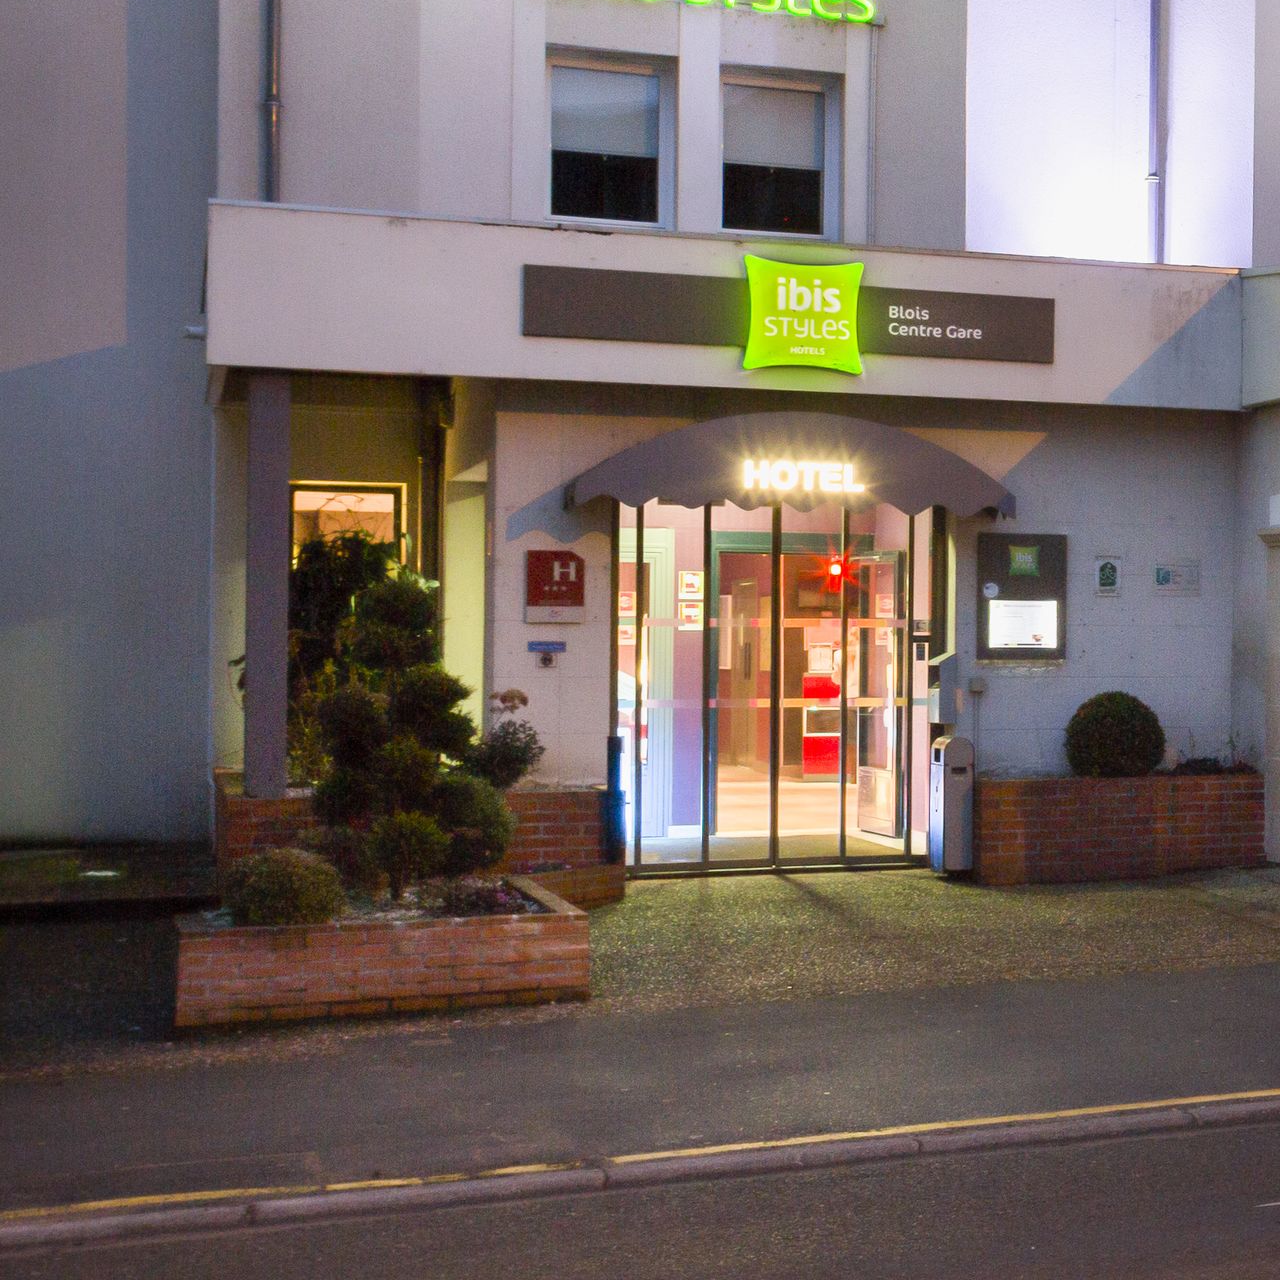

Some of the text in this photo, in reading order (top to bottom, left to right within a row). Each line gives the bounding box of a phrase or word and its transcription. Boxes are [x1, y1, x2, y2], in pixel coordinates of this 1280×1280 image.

[777, 276, 842, 313] ibis
[888, 305, 930, 320] Blois
[888, 322, 983, 340] Centre Gare
[789, 346, 826, 356] HOTELS
[743, 458, 866, 493] HOTEL
[553, 561, 576, 581] H
